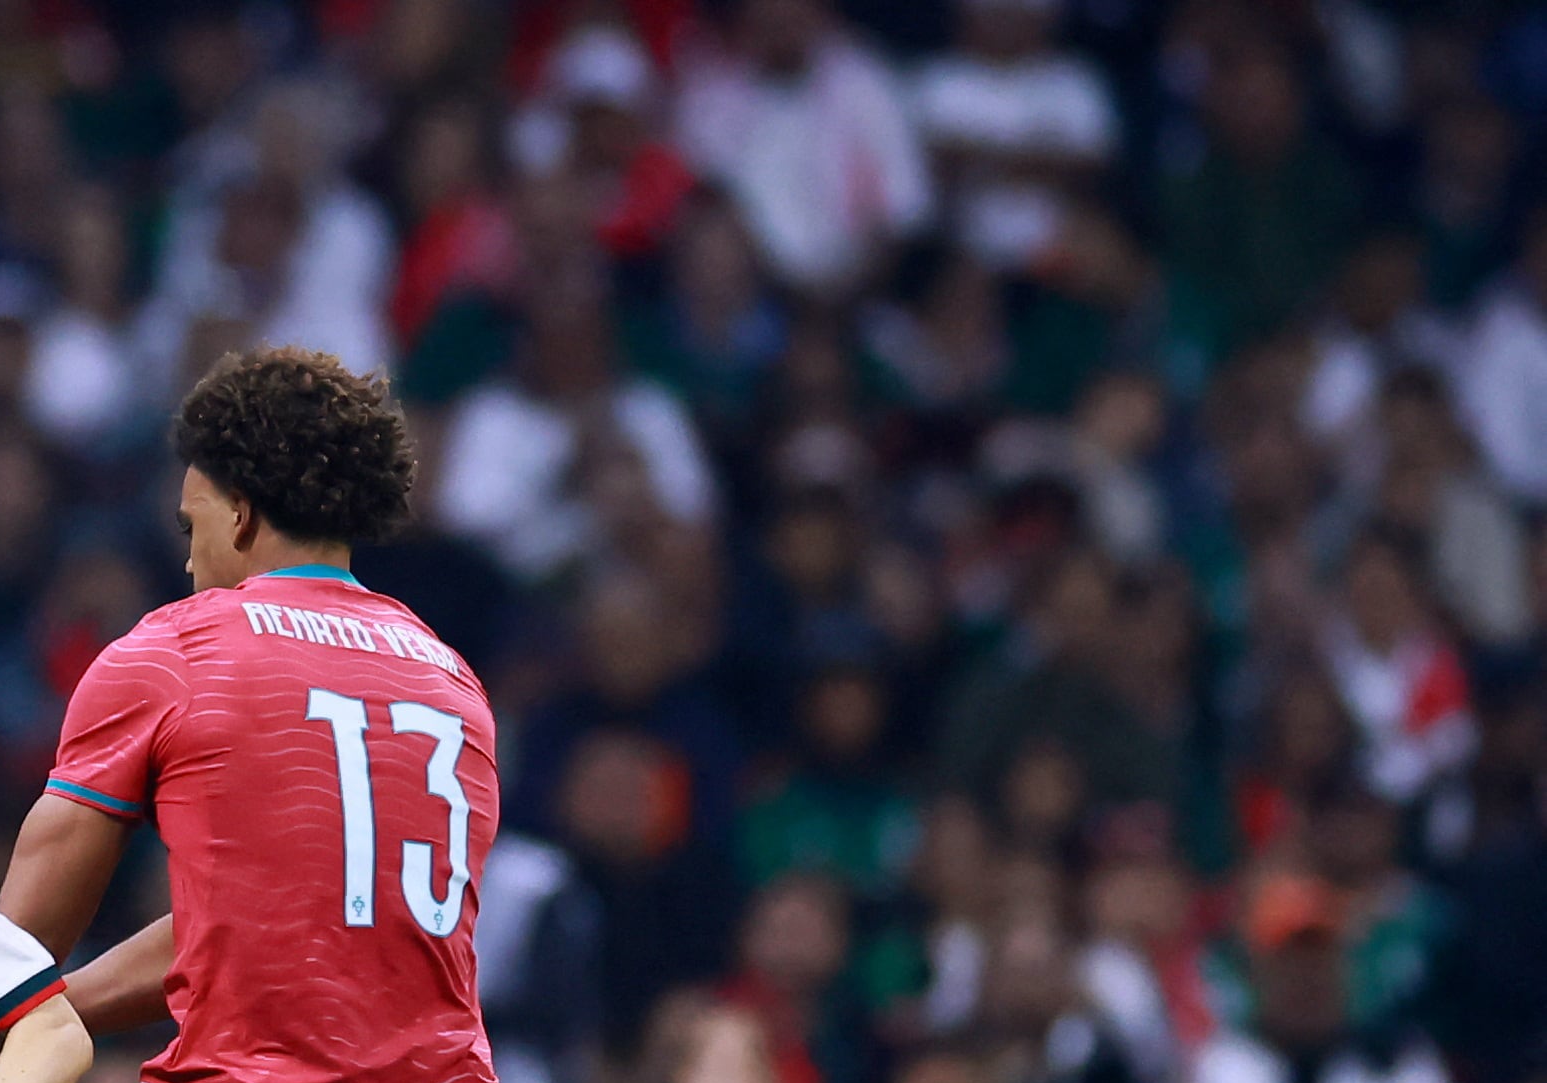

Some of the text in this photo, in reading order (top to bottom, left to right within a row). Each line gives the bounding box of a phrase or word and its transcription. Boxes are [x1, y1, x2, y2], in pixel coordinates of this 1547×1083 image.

[241, 602, 461, 677] RENATO VEIGA
[305, 687, 471, 938] 13
